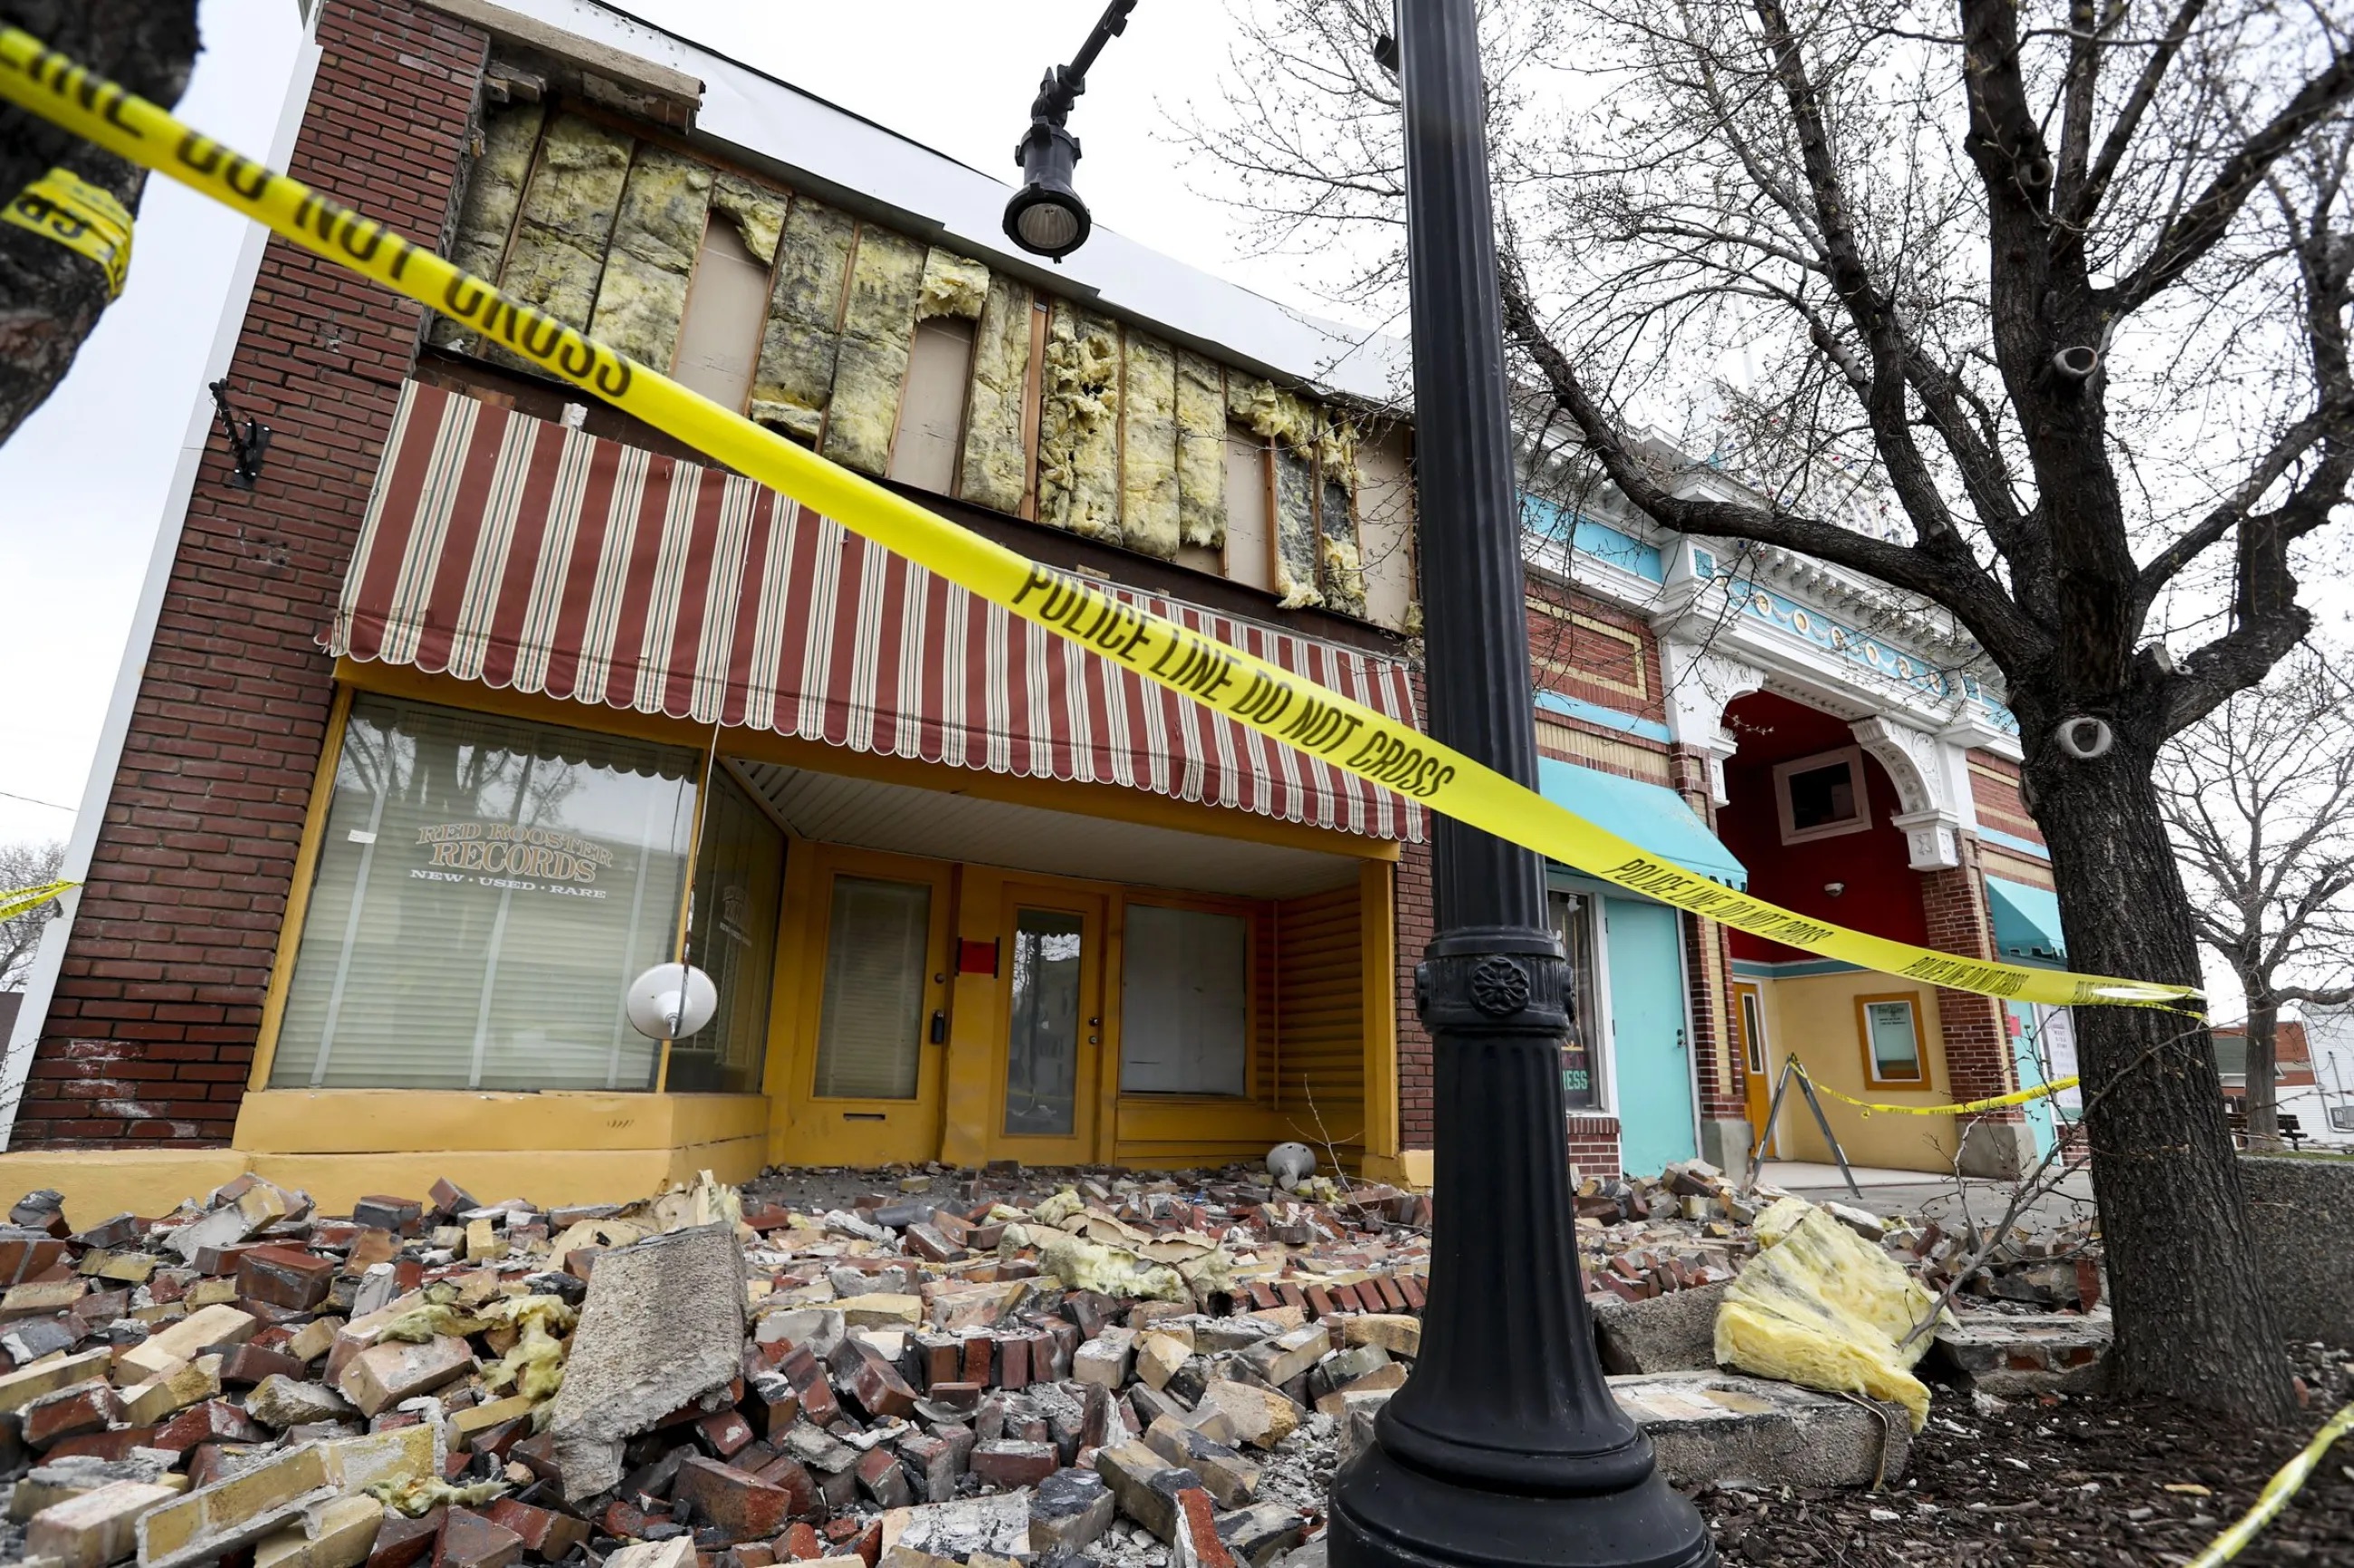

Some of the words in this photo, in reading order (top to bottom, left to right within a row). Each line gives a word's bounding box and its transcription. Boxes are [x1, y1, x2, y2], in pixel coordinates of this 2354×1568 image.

[1010, 561, 1157, 663] POLICE
[1149, 628, 1242, 702] LINE
[1229, 669, 1293, 724] DO
[1279, 695, 1364, 754] NOT
[1345, 730, 1456, 798] CROSS
[416, 823, 481, 845] RED
[487, 823, 614, 867] ROOSTER
[428, 841, 597, 884] RECORDS
[1600, 858, 1695, 894] POLICE
[409, 869, 464, 883] NEW
[479, 876, 536, 891] USED
[549, 884, 607, 899] RARE
[1666, 885, 1733, 909] LINE
[1703, 901, 1756, 918] DO
[1728, 909, 1790, 929] NOT
[1762, 920, 1834, 944] CROSS
[1563, 1069, 1589, 1091] ESS
